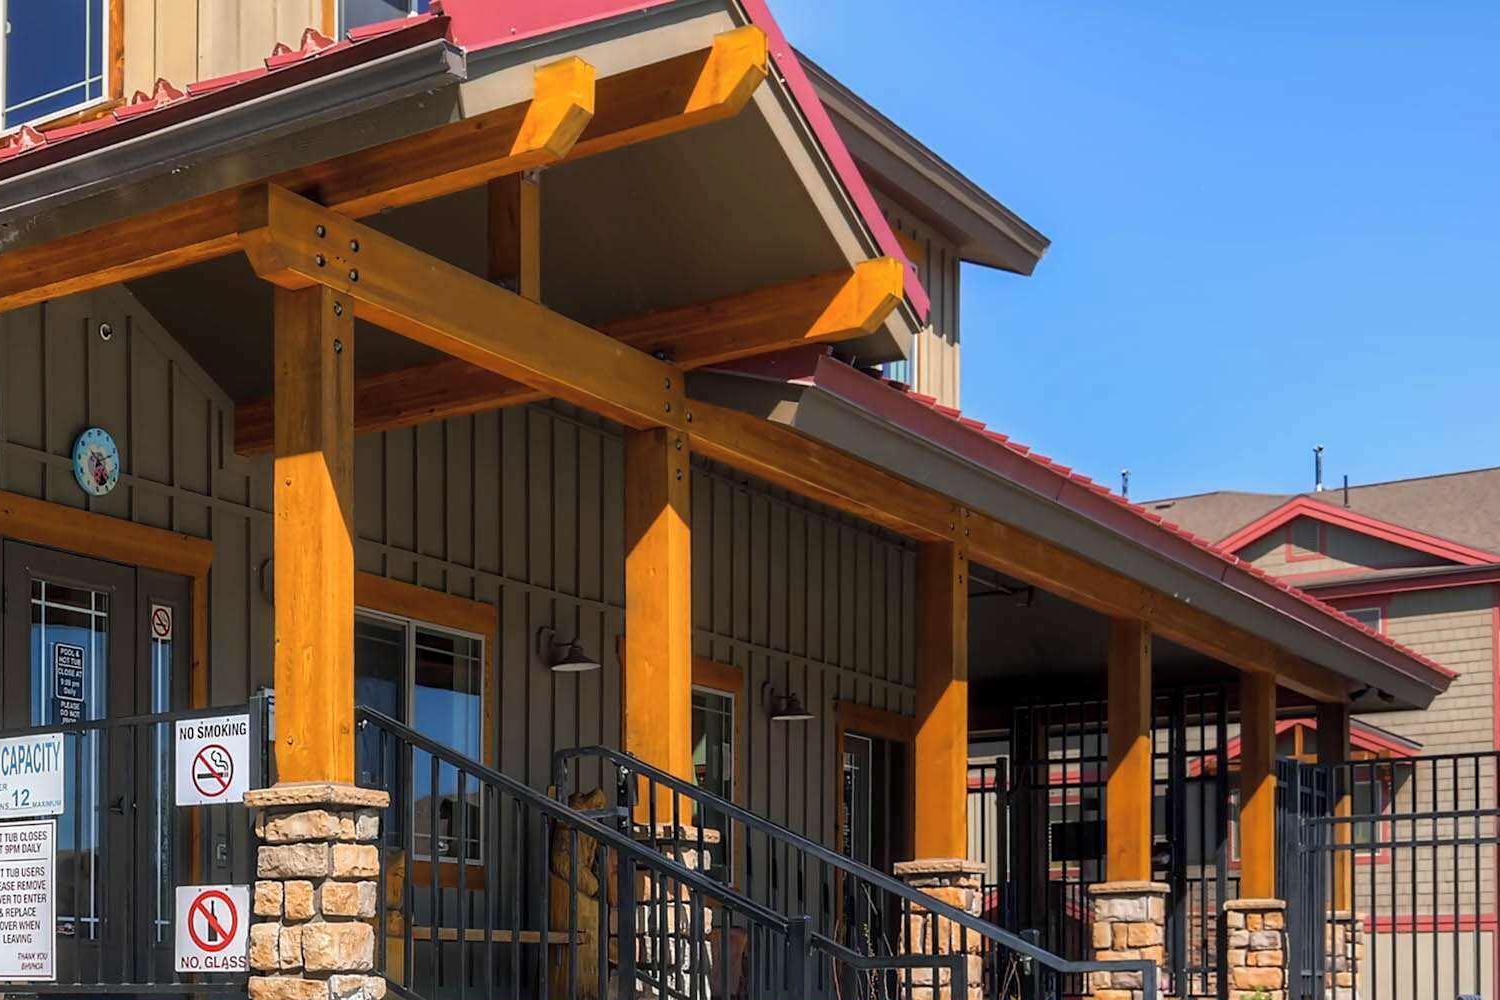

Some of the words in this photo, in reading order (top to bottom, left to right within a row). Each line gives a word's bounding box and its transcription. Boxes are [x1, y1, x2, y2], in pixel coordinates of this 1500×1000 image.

[60, 648, 75, 657] POOL
[60, 701, 80, 710] PLEASE
[179, 727, 194, 740] NO
[197, 722, 247, 739] SMOKING
[2, 741, 60, 776] CAPACITY
[12, 788, 30, 807] 12
[32, 800, 61, 808] MAXIMUM
[5, 832, 18, 842] TUB
[20, 831, 48, 841] CLOSES
[4, 844, 20, 854] 9PM
[22, 843, 41, 853] DAILY
[6, 868, 19, 878] TUB
[21, 866, 45, 877] USERS
[17, 880, 46, 890] REMOVE
[13, 894, 22, 904] TO
[24, 893, 47, 903] ENTER
[6, 907, 36, 917] REPLACE
[19, 920, 40, 930] WHEN
[3, 934, 32, 944] LEAVING
[17, 952, 37, 960] THANK
[37, 952, 48, 960] YOU
[181, 956, 199, 969] NO
[204, 954, 247, 969] GLASS
